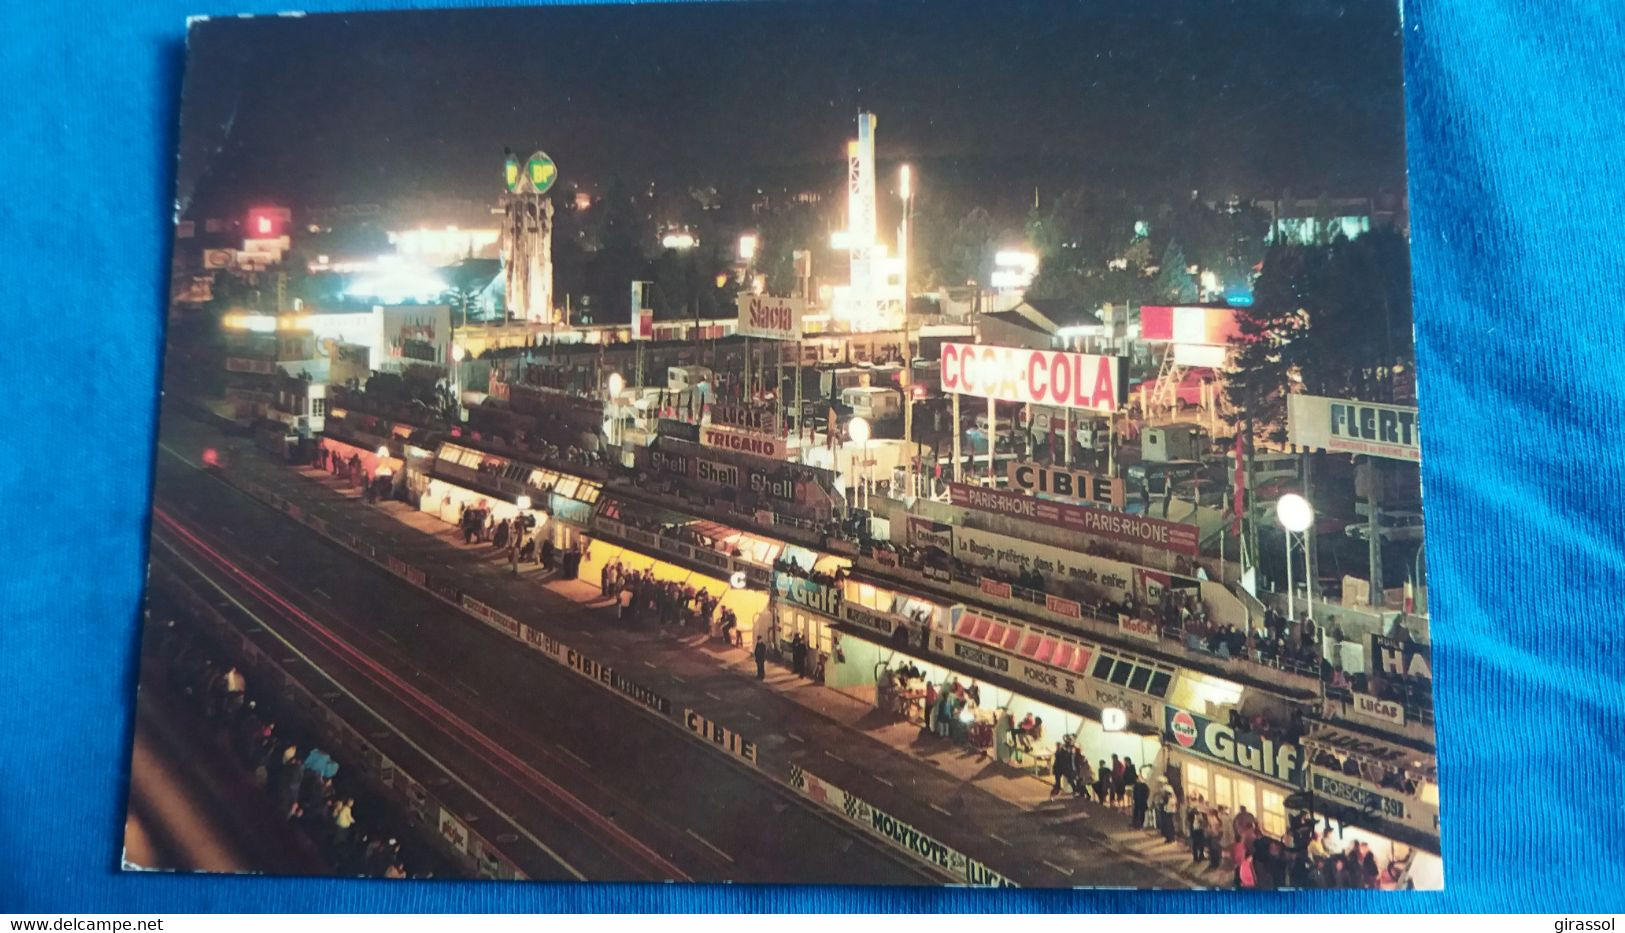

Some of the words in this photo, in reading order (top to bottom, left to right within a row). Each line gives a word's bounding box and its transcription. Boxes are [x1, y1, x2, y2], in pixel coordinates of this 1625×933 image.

[533, 164, 554, 184] BP
[750, 298, 793, 331] Slavia
[1331, 403, 1419, 445] FLERT
[706, 431, 775, 456] TRIGANO
[652, 452, 687, 474] Shell
[699, 462, 737, 486] Shell
[751, 473, 792, 499] Shell
[1015, 466, 1112, 504] CIBIE
[958, 536, 967, 551] La
[970, 539, 995, 560] Bougie
[1033, 555, 1053, 573] dans
[1057, 560, 1065, 575] le
[1069, 567, 1098, 584] monde
[1101, 574, 1127, 590] entier
[792, 577, 838, 614] Gulf
[567, 647, 611, 685] CIBIE
[1024, 666, 1058, 687] PORSCHE
[1360, 697, 1398, 718] LUCAS
[687, 710, 757, 765] CIBIE
[1205, 722, 1297, 781] Gulf
[872, 808, 949, 868] MOLYKOTE
